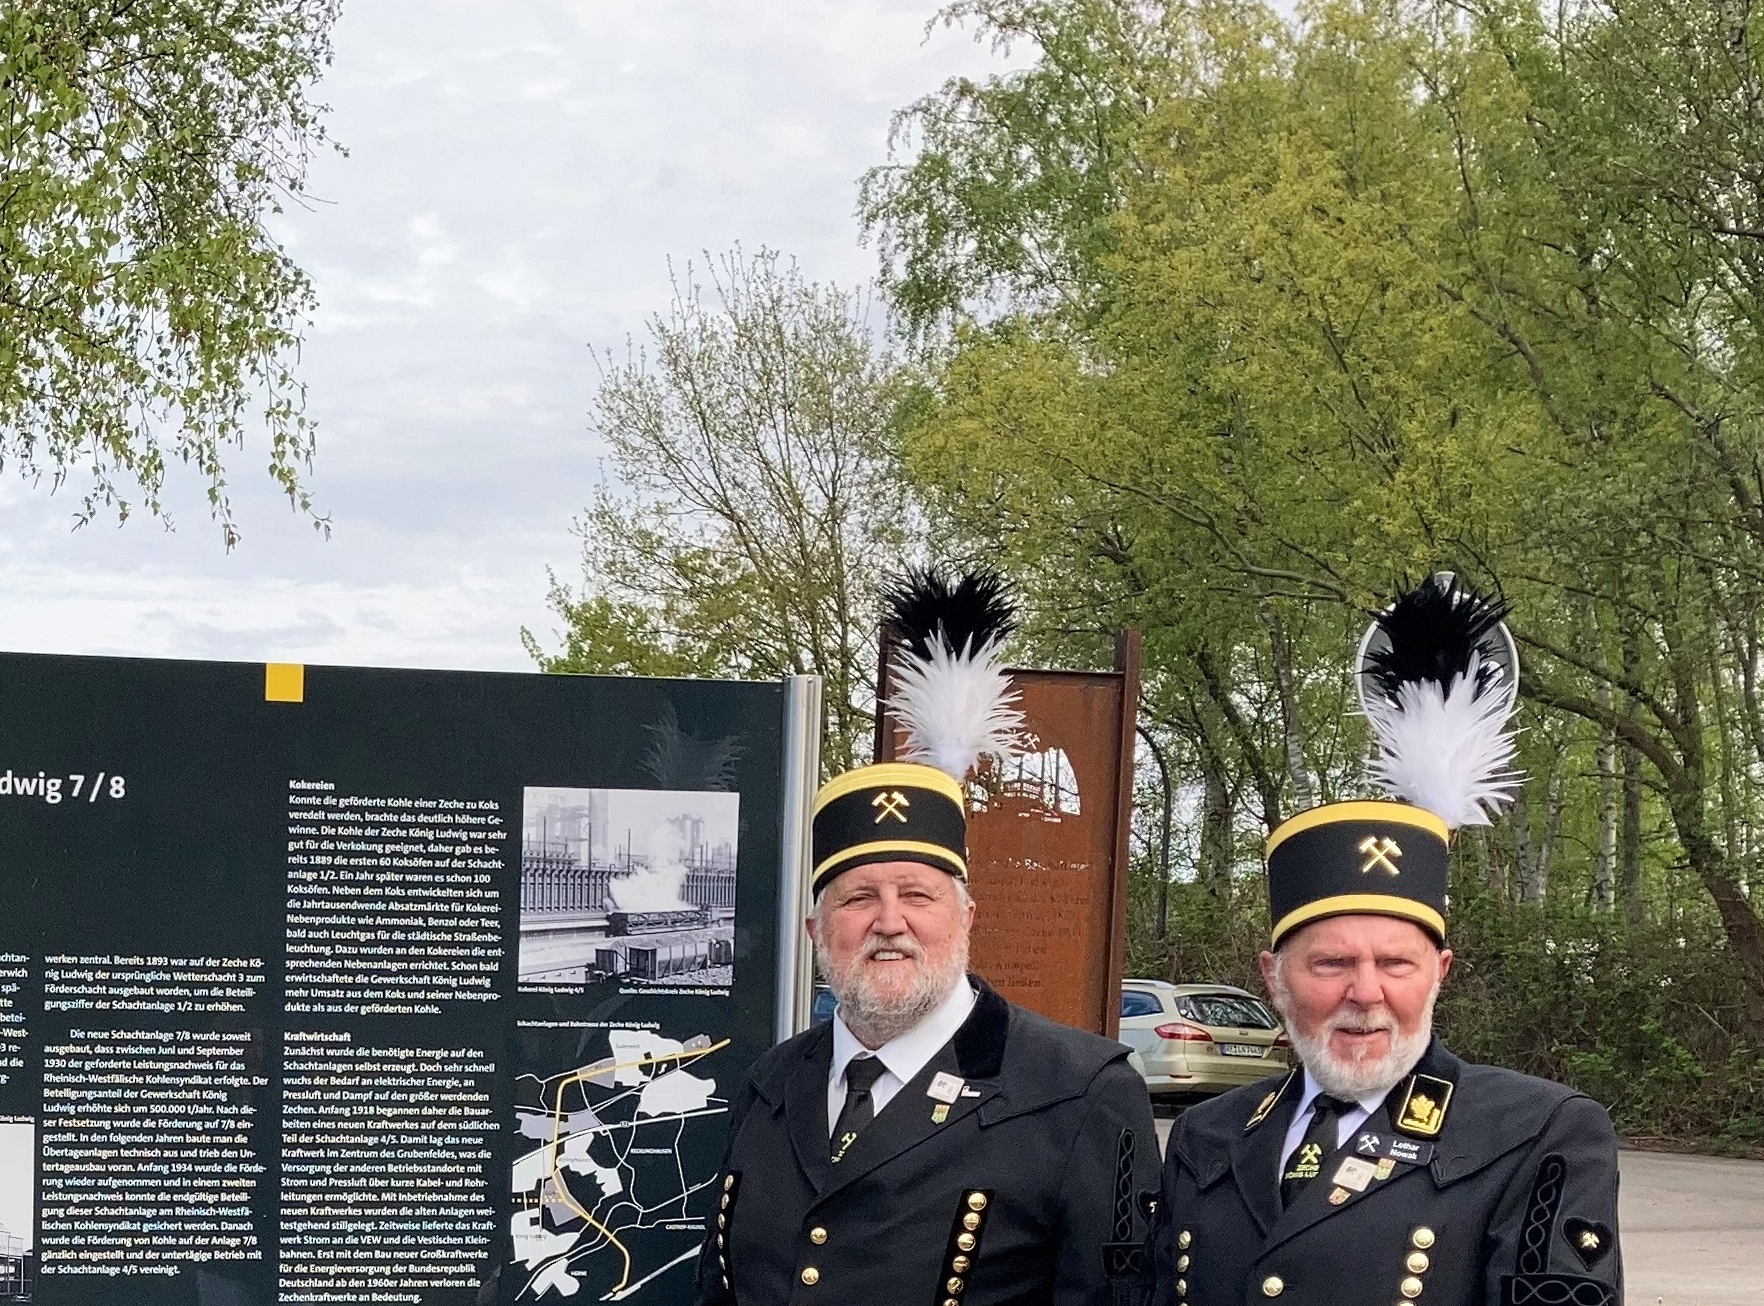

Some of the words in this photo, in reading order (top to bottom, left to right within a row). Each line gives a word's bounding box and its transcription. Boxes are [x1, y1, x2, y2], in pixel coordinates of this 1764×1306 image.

[70, 775, 84, 798] 7
[110, 776, 126, 799] 8
[289, 780, 335, 791] Kokereien
[289, 795, 322, 805] Konnte
[323, 796, 338, 806] die
[338, 796, 386, 809] geförderte
[387, 798, 413, 808] Kohle
[414, 798, 437, 808] einer
[438, 799, 465, 809] Zeche
[466, 802, 477, 810] zu
[478, 800, 499, 810] Koks
[288, 810, 325, 820] veredelt
[327, 811, 364, 822] werden,
[365, 812, 399, 822] brachte
[400, 813, 416, 823] das
[417, 814, 454, 824] deutlich
[455, 814, 486, 825] höhere
[487, 815, 504, 825] Ge-
[44, 954, 78, 964] werken
[80, 955, 112, 965] zentral.
[114, 956, 144, 966] Bereits
[146, 957, 168, 966] 1893
[189, 957, 205, 967] auf
[205, 958, 220, 967] der
[222, 958, 248, 968] Zeche
[250, 958, 265, 968] Kö-
[285, 959, 342, 970] sprechenden
[344, 960, 408, 972] Nebenanlagen
[409, 961, 450, 971] errichtet.
[451, 962, 478, 971] Schon
[479, 962, 499, 971] bald
[1, 983, 20, 995] spä-
[45, 984, 107, 995] Förderschacht
[108, 986, 154, 998] ausgebaut
[156, 987, 192, 997] worden,
[210, 987, 224, 997] die
[226, 987, 256, 997] Beteili-
[284, 1032, 352, 1042] Kraftwirtschaft
[44, 1044, 93, 1056] ausgebaut,
[94, 1044, 114, 1054] dass
[115, 1045, 156, 1055] zwischen
[158, 1045, 176, 1055] Juni
[177, 1046, 195, 1055] und
[196, 1046, 244, 1058] September
[9, 1058, 24, 1067] die
[1393, 1140, 1420, 1151] Lothar
[1389, 1148, 1418, 1160] Nowak
[42, 1163, 106, 1174] tertageausbau
[137, 1163, 170, 1175] Anfang
[171, 1164, 193, 1173] 1934
[194, 1163, 222, 1173] wurde
[224, 1163, 238, 1173] die
[239, 1163, 267, 1173] Förde-
[279, 1278, 334, 1288] Deutschland
[335, 1278, 347, 1288] ab
[348, 1278, 366, 1288] den
[367, 1279, 398, 1288] 1960er
[399, 1278, 428, 1288] Jahren
[429, 1279, 466, 1287] verloren
[467, 1278, 481, 1288] die
